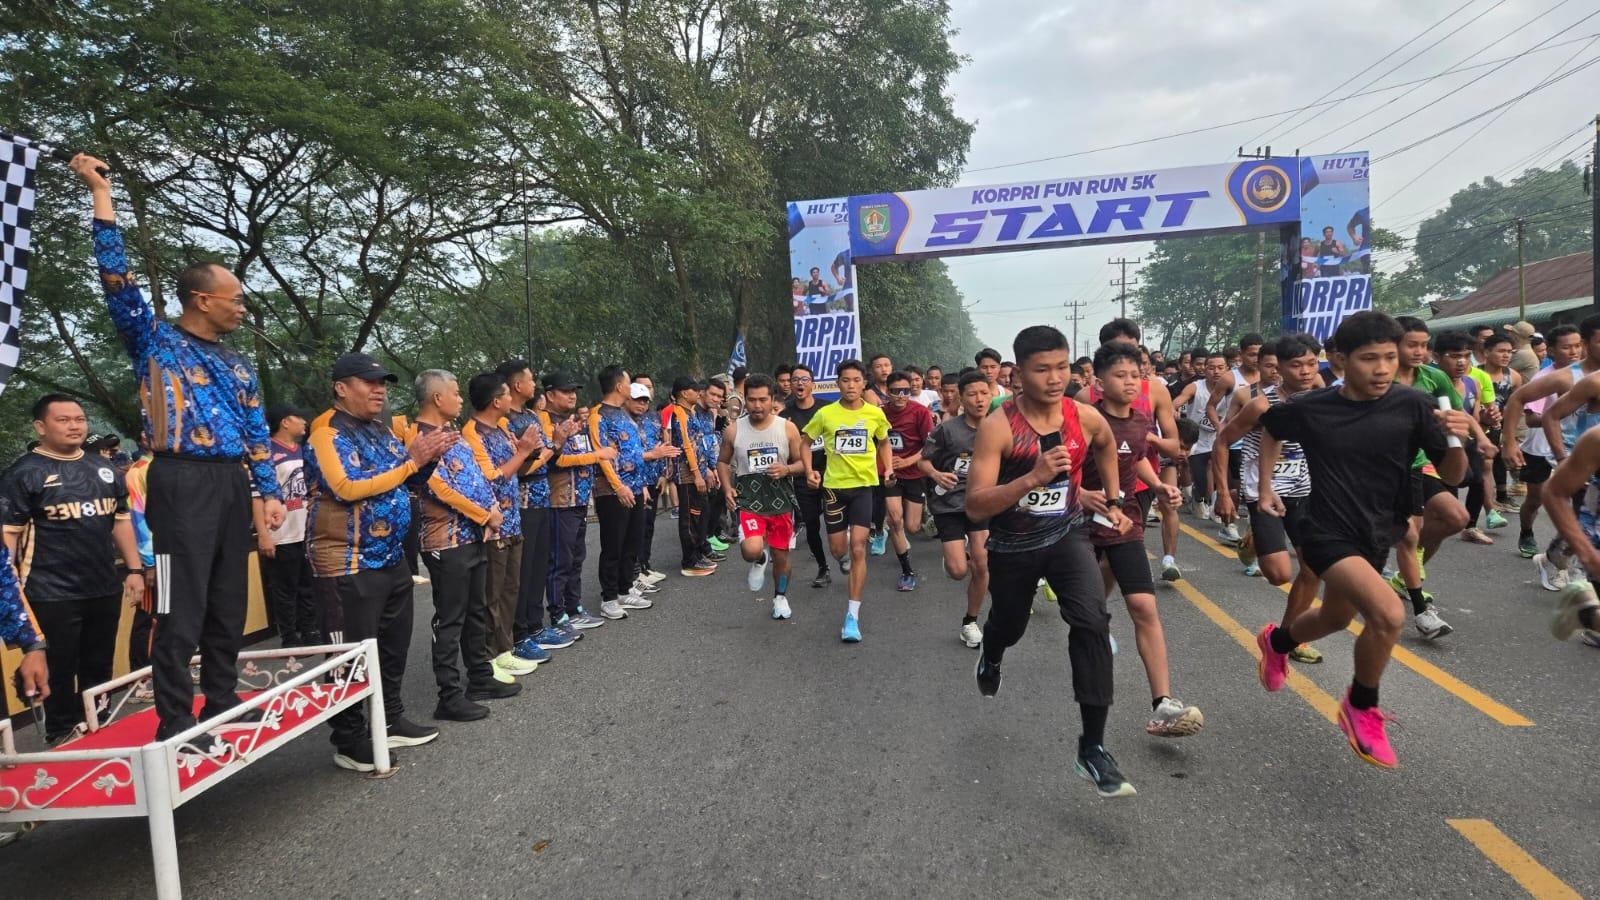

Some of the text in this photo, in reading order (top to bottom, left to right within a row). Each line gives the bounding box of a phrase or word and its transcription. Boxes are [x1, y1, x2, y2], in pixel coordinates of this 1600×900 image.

[1322, 157, 1360, 170] HUT
[972, 174, 1157, 205] KORPRI FUN RUN 5K
[807, 203, 839, 215] HUT
[925, 190, 1210, 247] START
[840, 437, 862, 448] 748
[753, 455, 774, 467] 180
[1027, 491, 1061, 507] 929
[745, 518, 759, 531] 13
